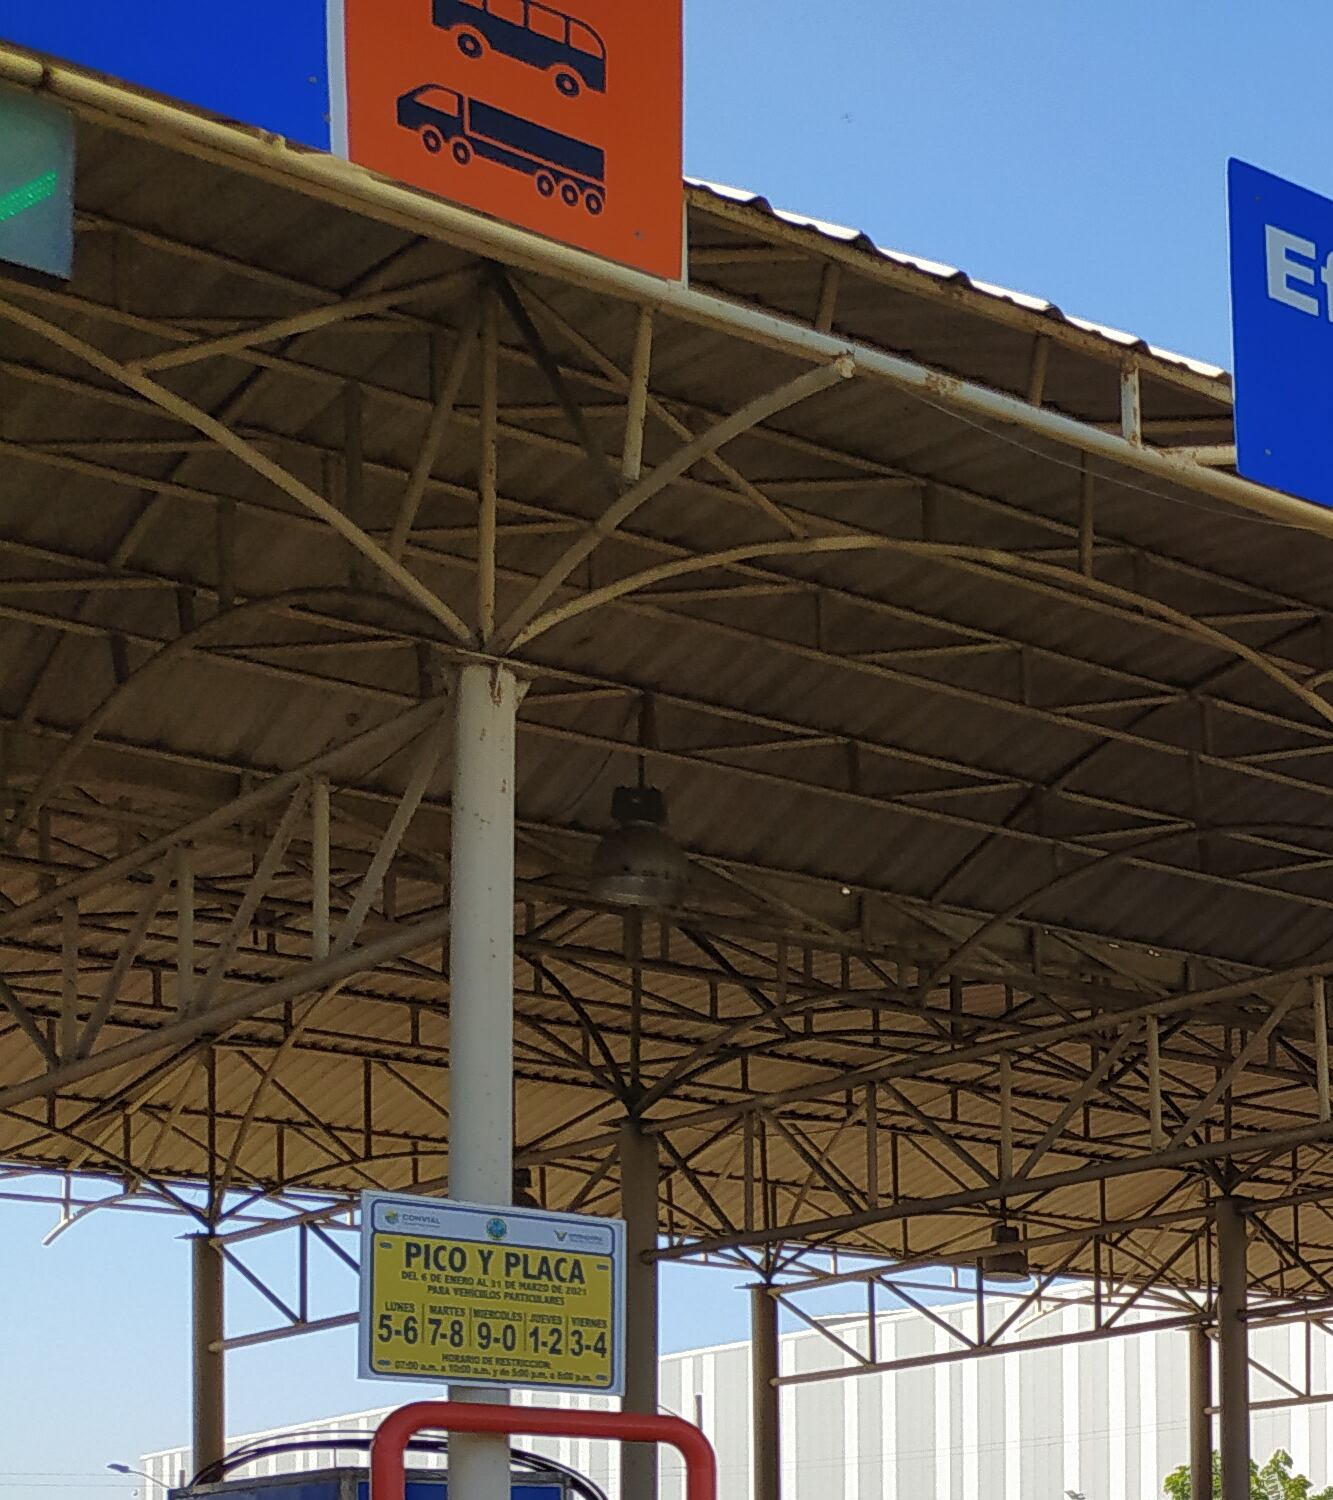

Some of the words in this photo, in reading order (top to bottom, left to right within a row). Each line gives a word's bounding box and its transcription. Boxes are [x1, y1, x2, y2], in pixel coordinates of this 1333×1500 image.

[405, 1241, 467, 1273] PICO
[477, 1249, 496, 1275] Y
[505, 1252, 586, 1285] PLACA
[401, 1271, 417, 1280] DEL
[430, 1273, 441, 1283] DE
[444, 1275, 474, 1286] ENERO
[476, 1278, 488, 1288] AL
[505, 1281, 515, 1290] DE
[519, 1282, 549, 1293] MARZO
[385, 1301, 415, 1313] LUNES
[429, 1305, 466, 1317] MARTES
[571, 1317, 607, 1329] VIERNES
[378, 1313, 419, 1345] 5-6
[428, 1317, 464, 1348] 7-8
[477, 1321, 516, 1351] 9-0
[529, 1326, 563, 1355] 1-2
[570, 1329, 607, 1359] 3-4
